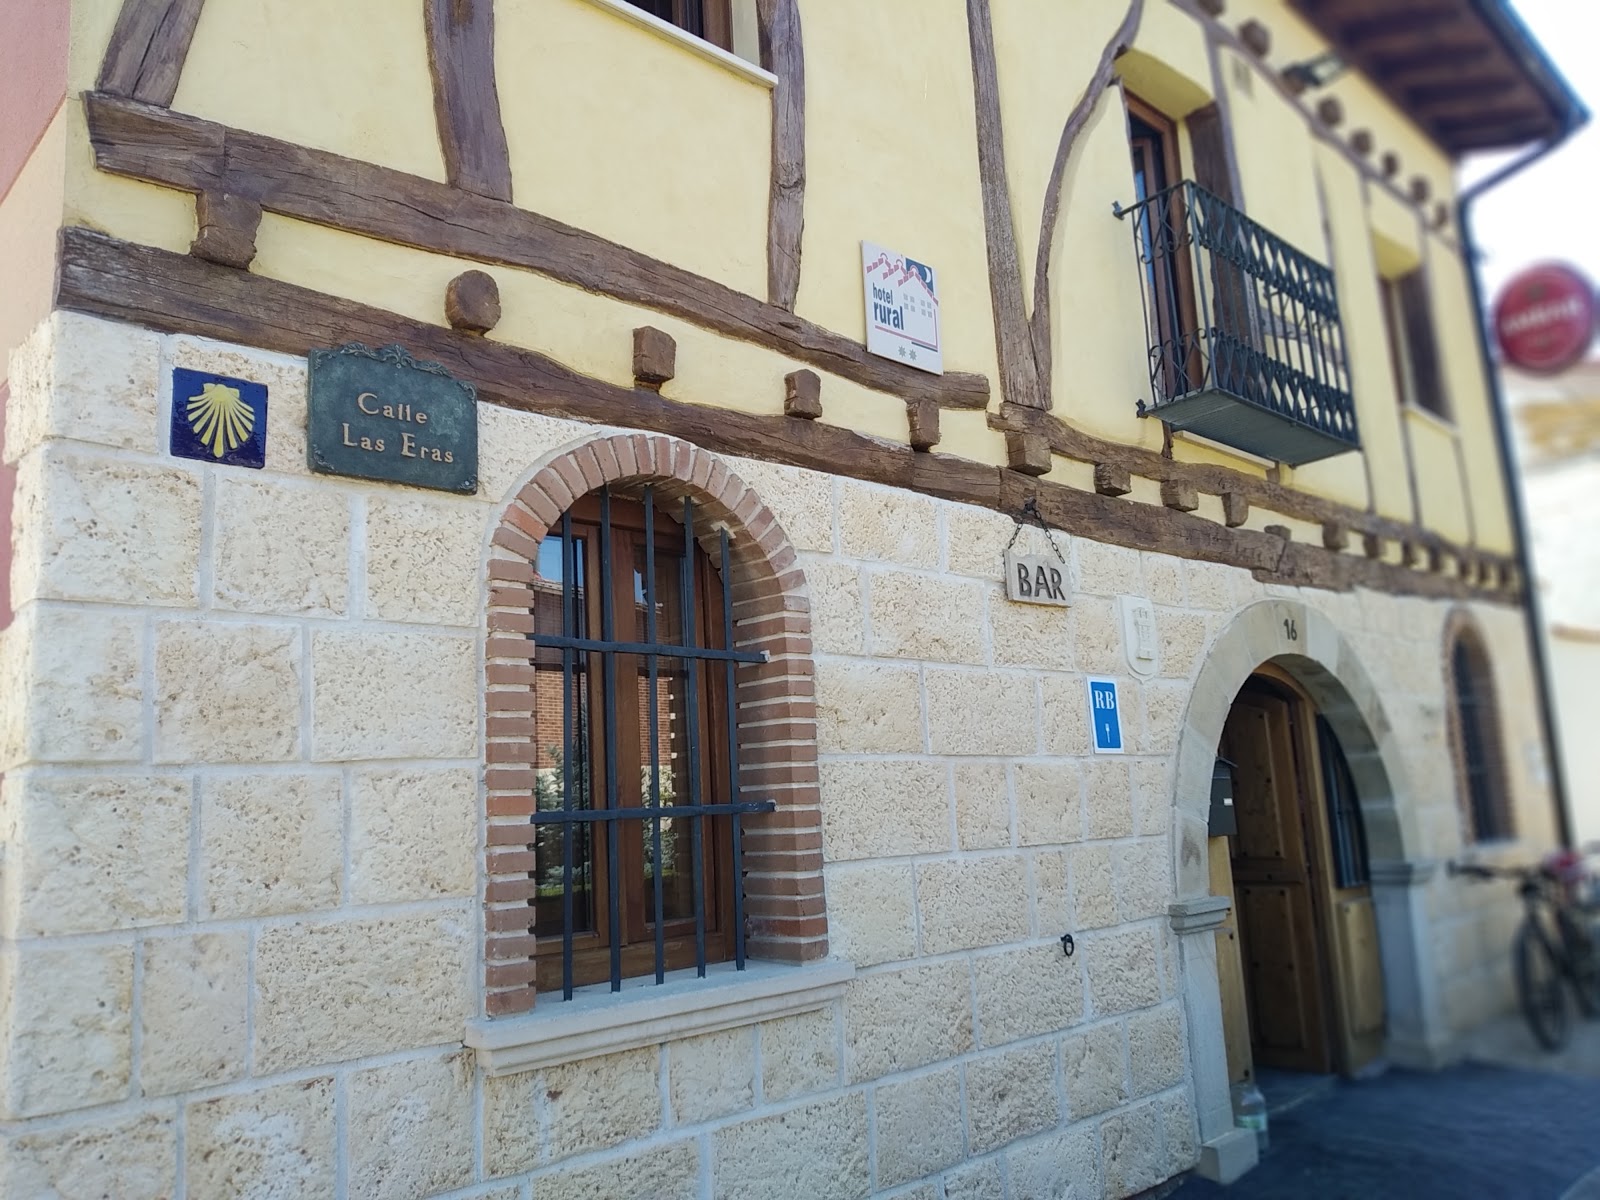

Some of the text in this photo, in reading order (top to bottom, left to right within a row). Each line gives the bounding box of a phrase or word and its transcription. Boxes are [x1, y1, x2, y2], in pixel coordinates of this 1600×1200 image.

[872, 282, 894, 306] hotel
[873, 301, 905, 331] rural
[357, 392, 428, 424] Calle
[342, 422, 454, 464] Las Eras
[1016, 562, 1066, 601] BAR
[1283, 618, 1298, 642] 16
[1093, 689, 1116, 710] RB
